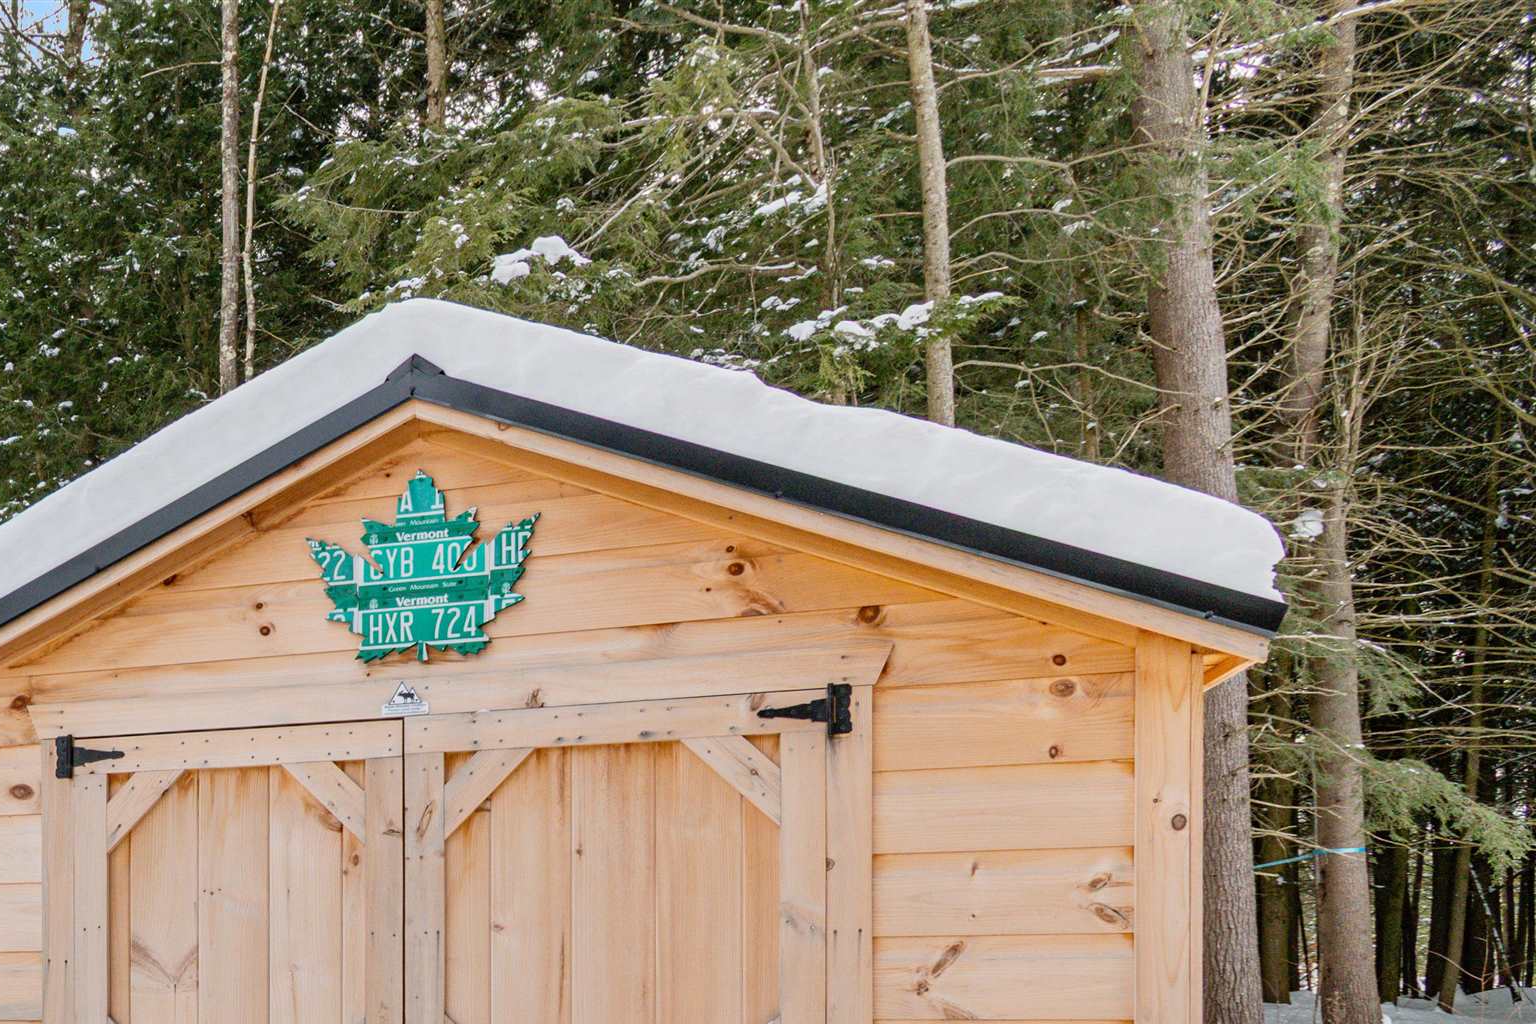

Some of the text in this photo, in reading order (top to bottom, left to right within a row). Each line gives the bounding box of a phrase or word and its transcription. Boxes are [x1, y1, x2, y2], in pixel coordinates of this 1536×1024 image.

[396, 528, 449, 542] Vermont
[312, 550, 346, 581] 22
[396, 593, 449, 607] Vermont
[369, 605, 477, 645] HXR 724
